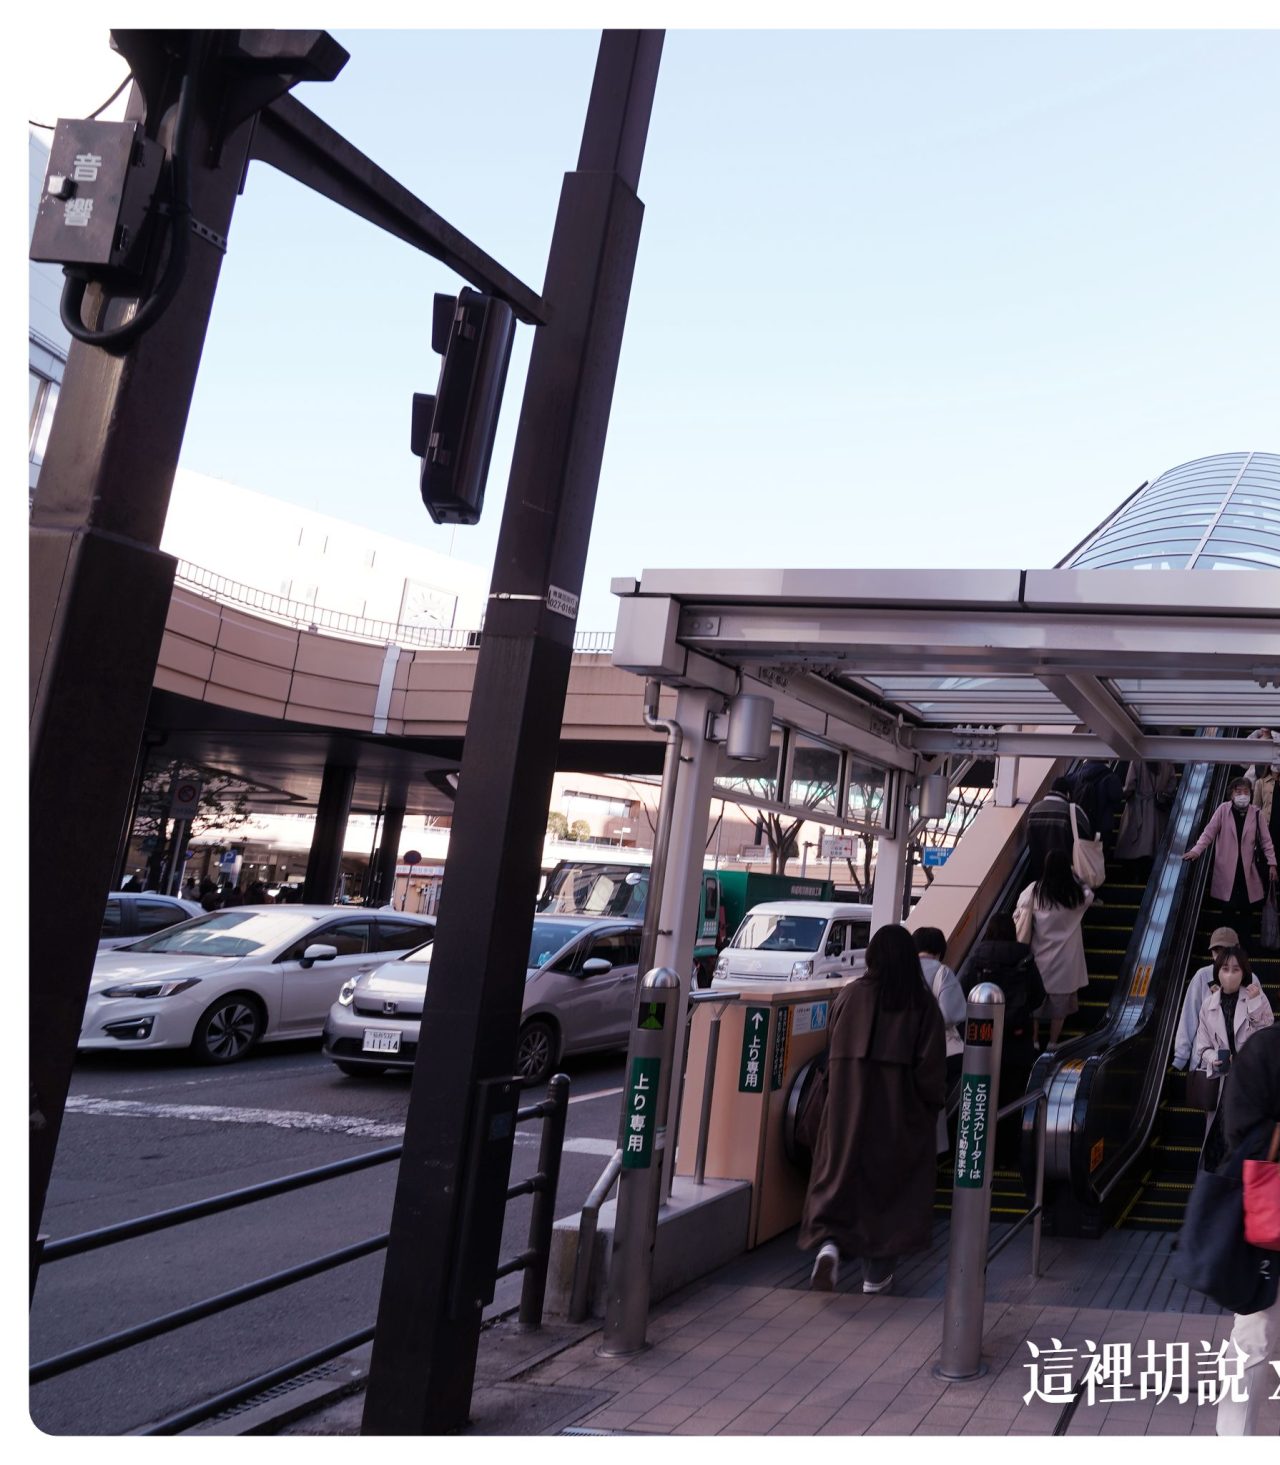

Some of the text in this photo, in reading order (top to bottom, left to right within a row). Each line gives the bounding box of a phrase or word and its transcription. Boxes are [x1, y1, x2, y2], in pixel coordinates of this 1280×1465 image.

[64, 153, 103, 226] 音響
[745, 1035, 761, 1087] 上り専用
[967, 1023, 993, 1041] 自動
[627, 1072, 650, 1152] 上り専用
[957, 1082, 972, 1179] 人に反応して動きます
[969, 1083, 986, 1179] このエスカレーターは
